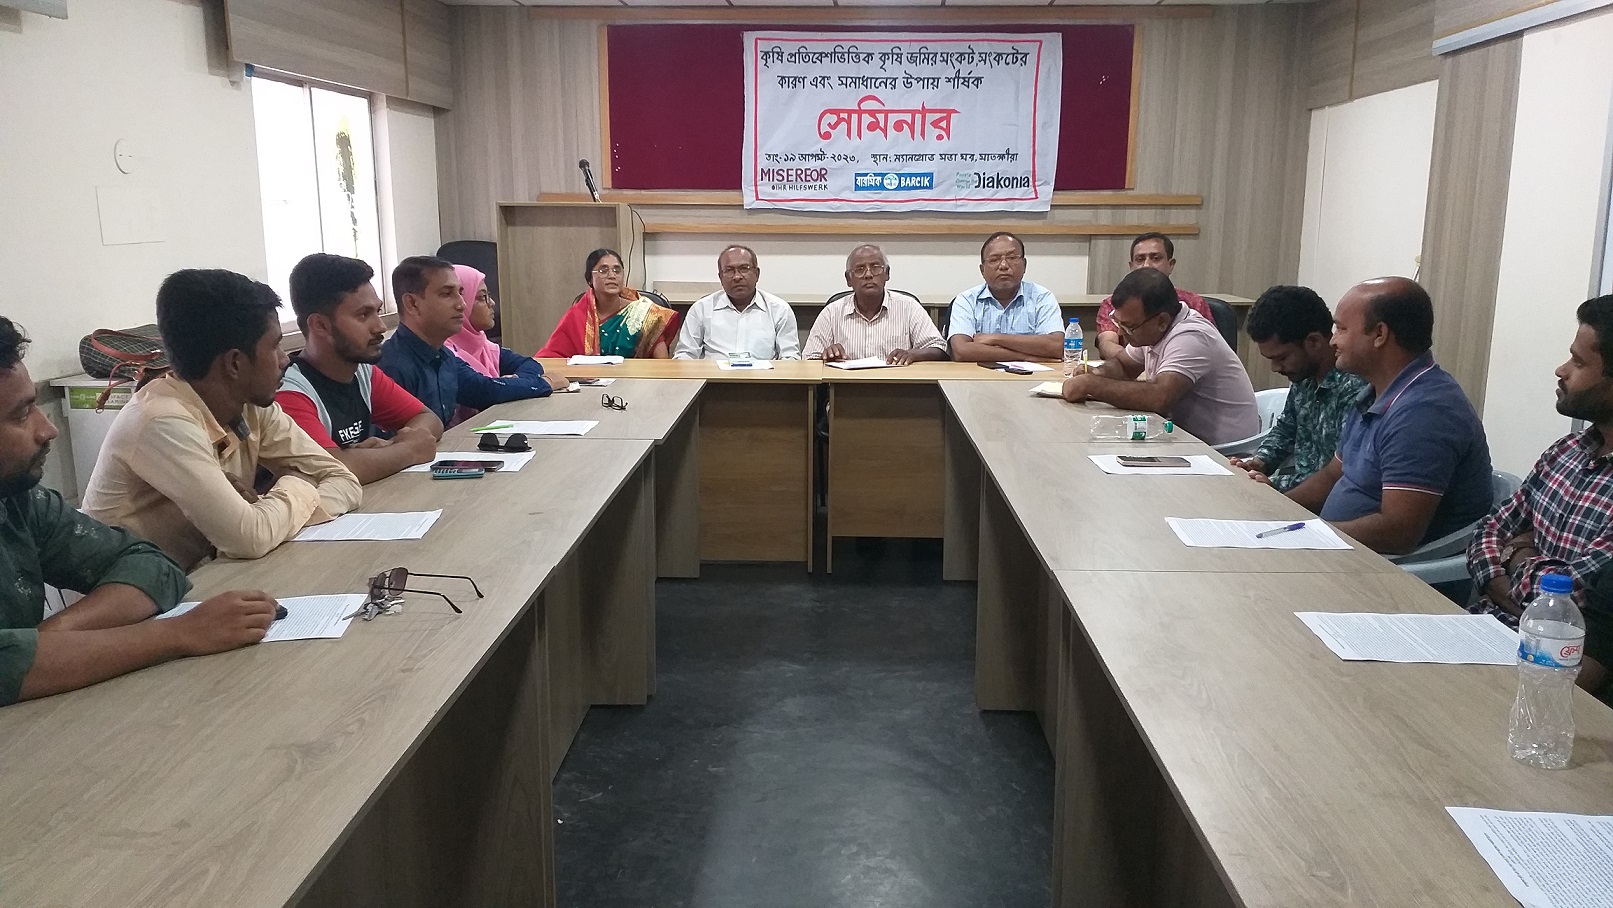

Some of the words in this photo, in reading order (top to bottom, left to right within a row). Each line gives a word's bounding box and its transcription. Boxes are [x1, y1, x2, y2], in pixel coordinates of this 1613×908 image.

[760, 45, 785, 68] কৃষি
[786, 45, 875, 64] প্রতিবেশভিত্তিক
[878, 46, 904, 72] কৃষি
[906, 46, 938, 67] জমির
[777, 75, 807, 89] কারণ
[809, 75, 834, 90] এবং
[837, 75, 898, 90] সমাধানের
[902, 70, 941, 90] উপায়
[945, 68, 984, 89] শীর্ষক
[817, 94, 961, 141] সেমিনার
[939, 153, 958, 162] সভা
[760, 167, 829, 183] MISEREOR
[900, 176, 931, 187] BARCIK
[973, 171, 1030, 189] Diakonia
